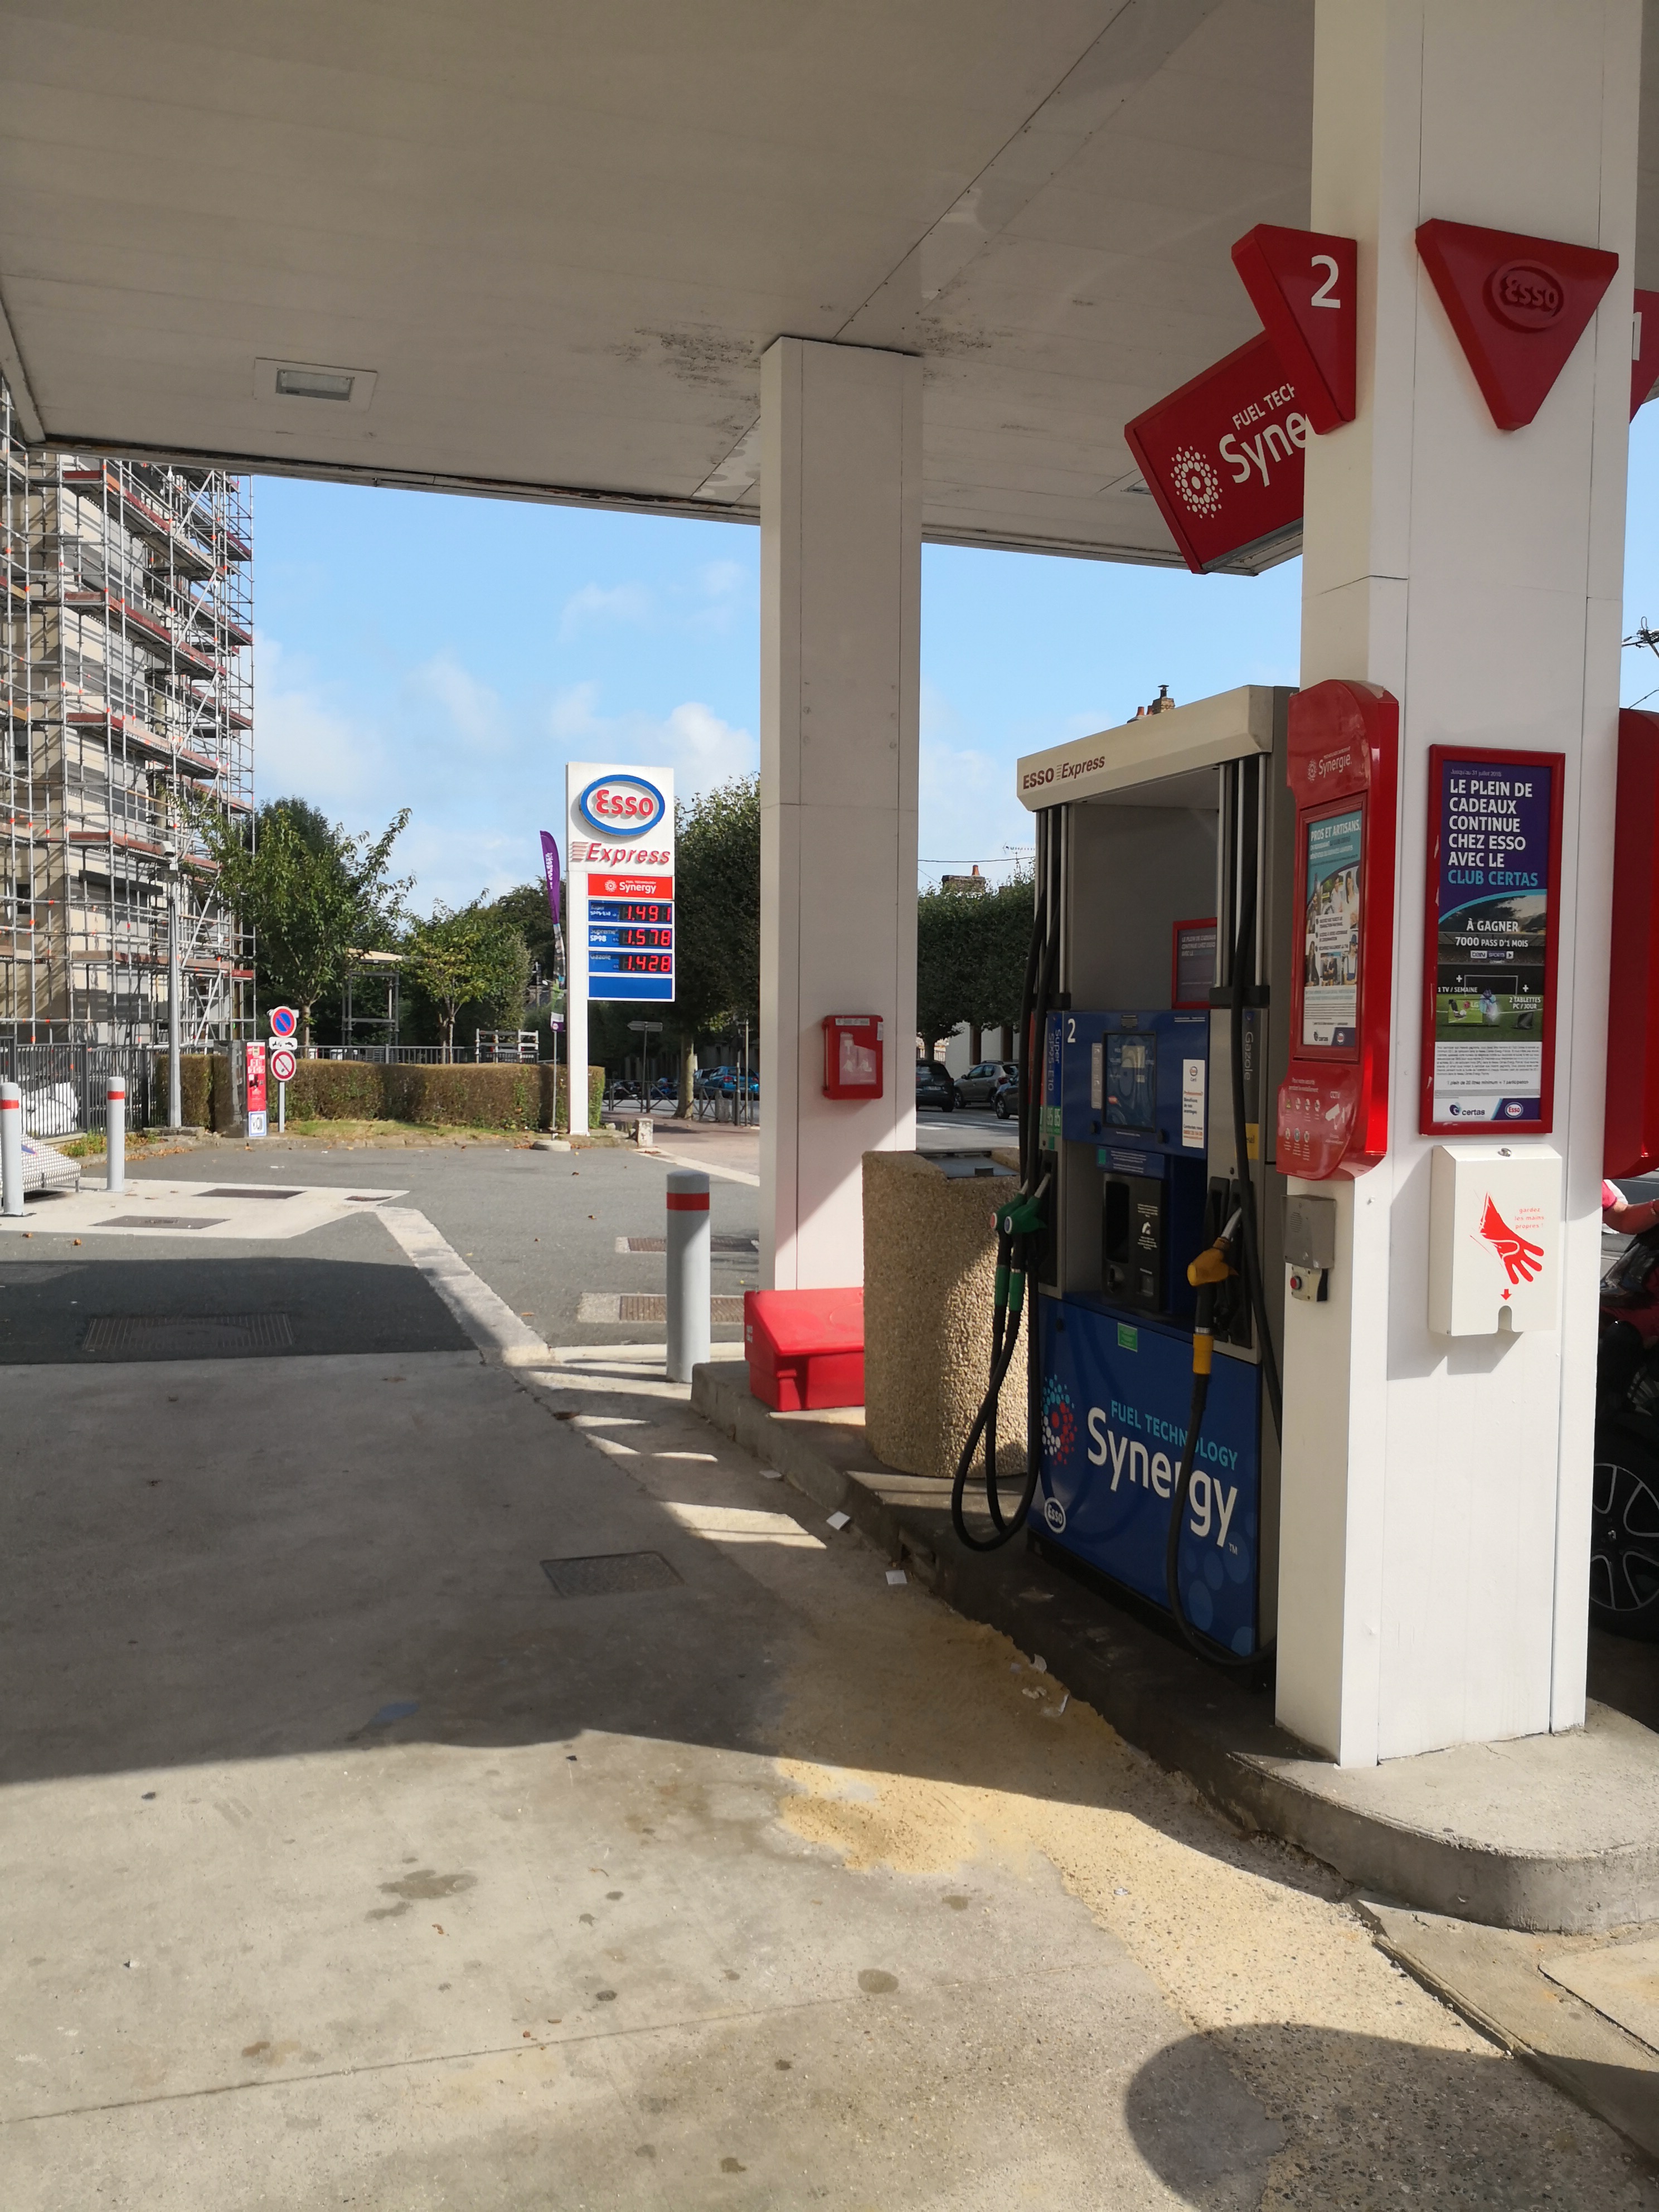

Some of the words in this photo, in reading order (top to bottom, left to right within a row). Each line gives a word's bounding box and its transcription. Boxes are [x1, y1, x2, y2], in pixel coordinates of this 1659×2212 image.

[1311, 254, 1341, 309] 2
[1505, 277, 1559, 311] Esso
[1232, 404, 1266, 431] FUEL
[1023, 767, 1054, 790] ESSO
[1061, 755, 1105, 780] Express
[1450, 779, 1466, 794] LE
[1471, 780, 1510, 797] PLEIN
[1515, 782, 1532, 798] DE
[595, 789, 653, 817] Esso
[1449, 797, 1517, 814] CADEAUX
[1449, 816, 1520, 833] CONTINUE
[1311, 828, 1325, 842] PROS
[1325, 826, 1332, 838] ET
[1448, 833, 1485, 849] CHEZ
[1489, 836, 1526, 851] ESSO
[586, 842, 671, 867] Express
[1448, 852, 1484, 867] AVEC
[1489, 853, 1505, 867] LE
[1448, 870, 1484, 885] CLUB
[1488, 871, 1539, 887] CERTAS
[619, 882, 657, 894] Synergy
[1467, 918, 1474, 932] À
[1477, 920, 1519, 932] GAGNER
[627, 929, 671, 946] 1.578
[1455, 937, 1479, 947] 7000
[627, 955, 671, 972] 1.428
[1067, 1018, 1076, 1043] 2
[1244, 1031, 1254, 1081] Gazole
[1110, 1399, 1142, 1430] FUEL
